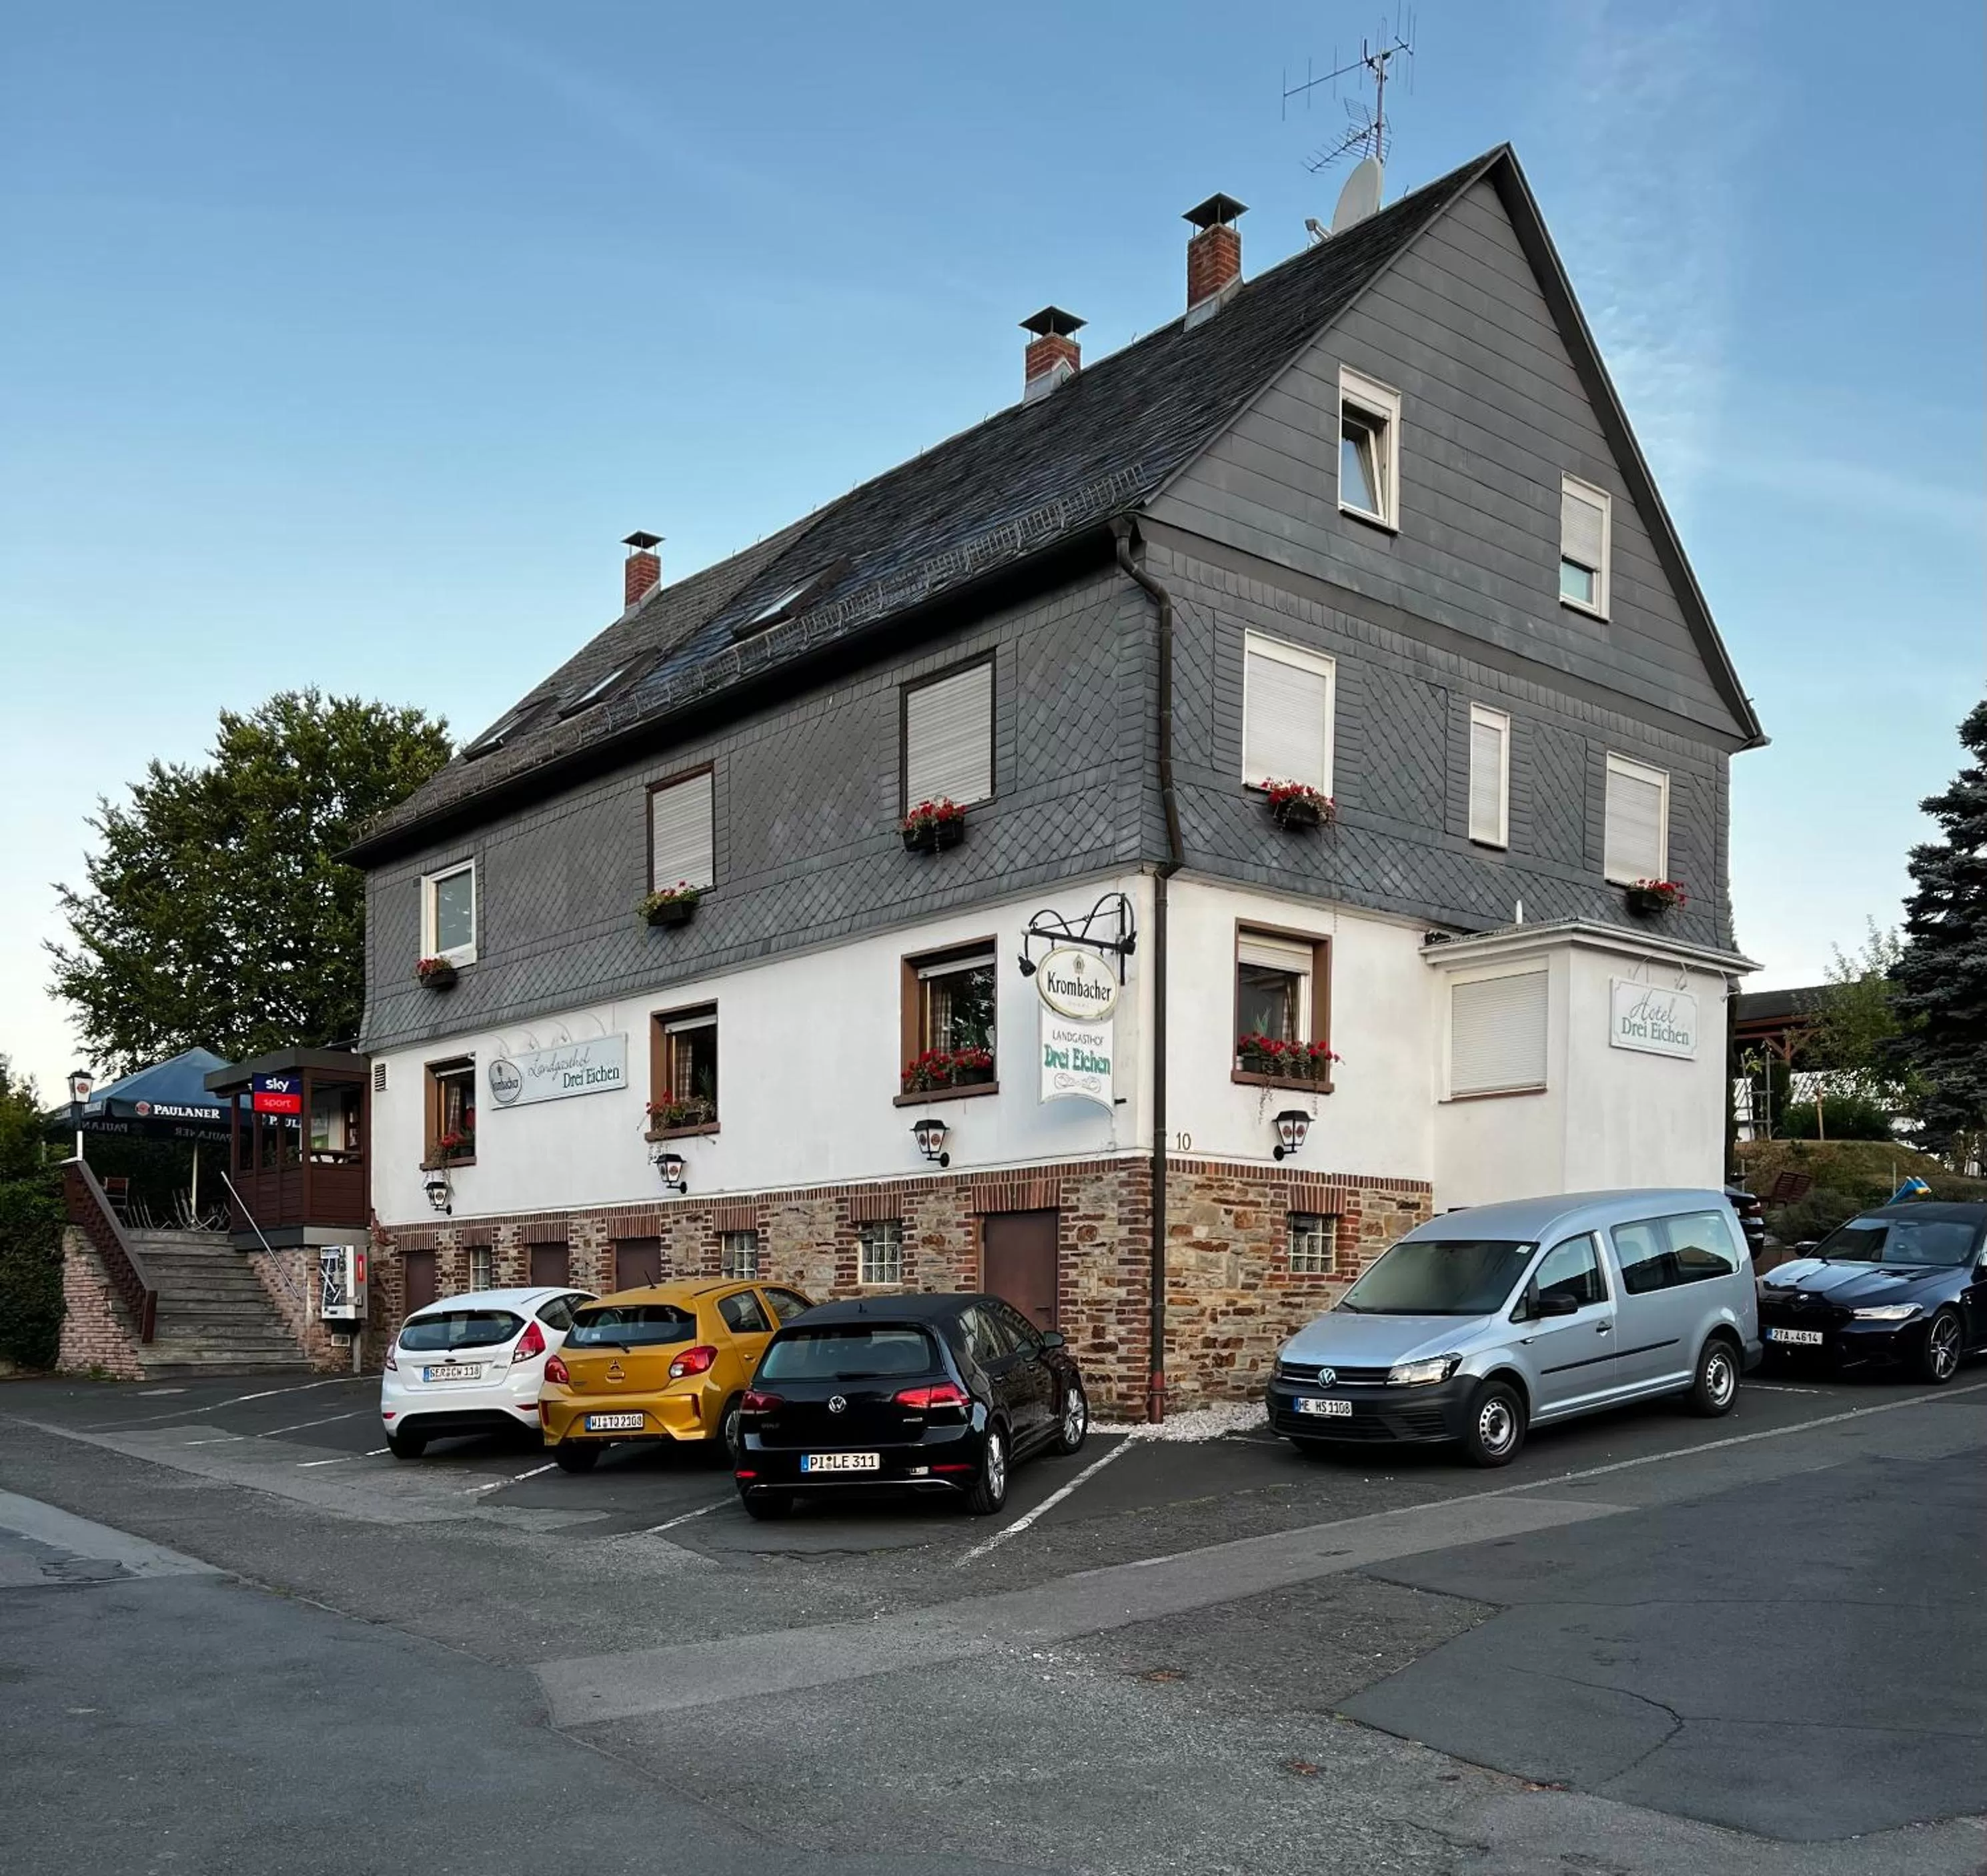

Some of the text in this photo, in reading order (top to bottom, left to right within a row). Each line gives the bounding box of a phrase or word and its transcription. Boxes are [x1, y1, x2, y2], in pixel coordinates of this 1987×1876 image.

[1047, 971, 1112, 1001] Krombacher
[1630, 990, 1677, 1023] Hotel
[1052, 1029, 1105, 1046] LANDGASTHOF
[1621, 1017, 1689, 1045] Drei Eichen
[1044, 1044, 1111, 1075] Drei Eichen
[265, 1078, 289, 1092] sky
[563, 1065, 620, 1089] Drei Eichen
[153, 1104, 220, 1119] PAULANER
[263, 1099, 291, 1108] sport
[1176, 1131, 1191, 1151] 10
[810, 1455, 875, 1469] PI LE 311
